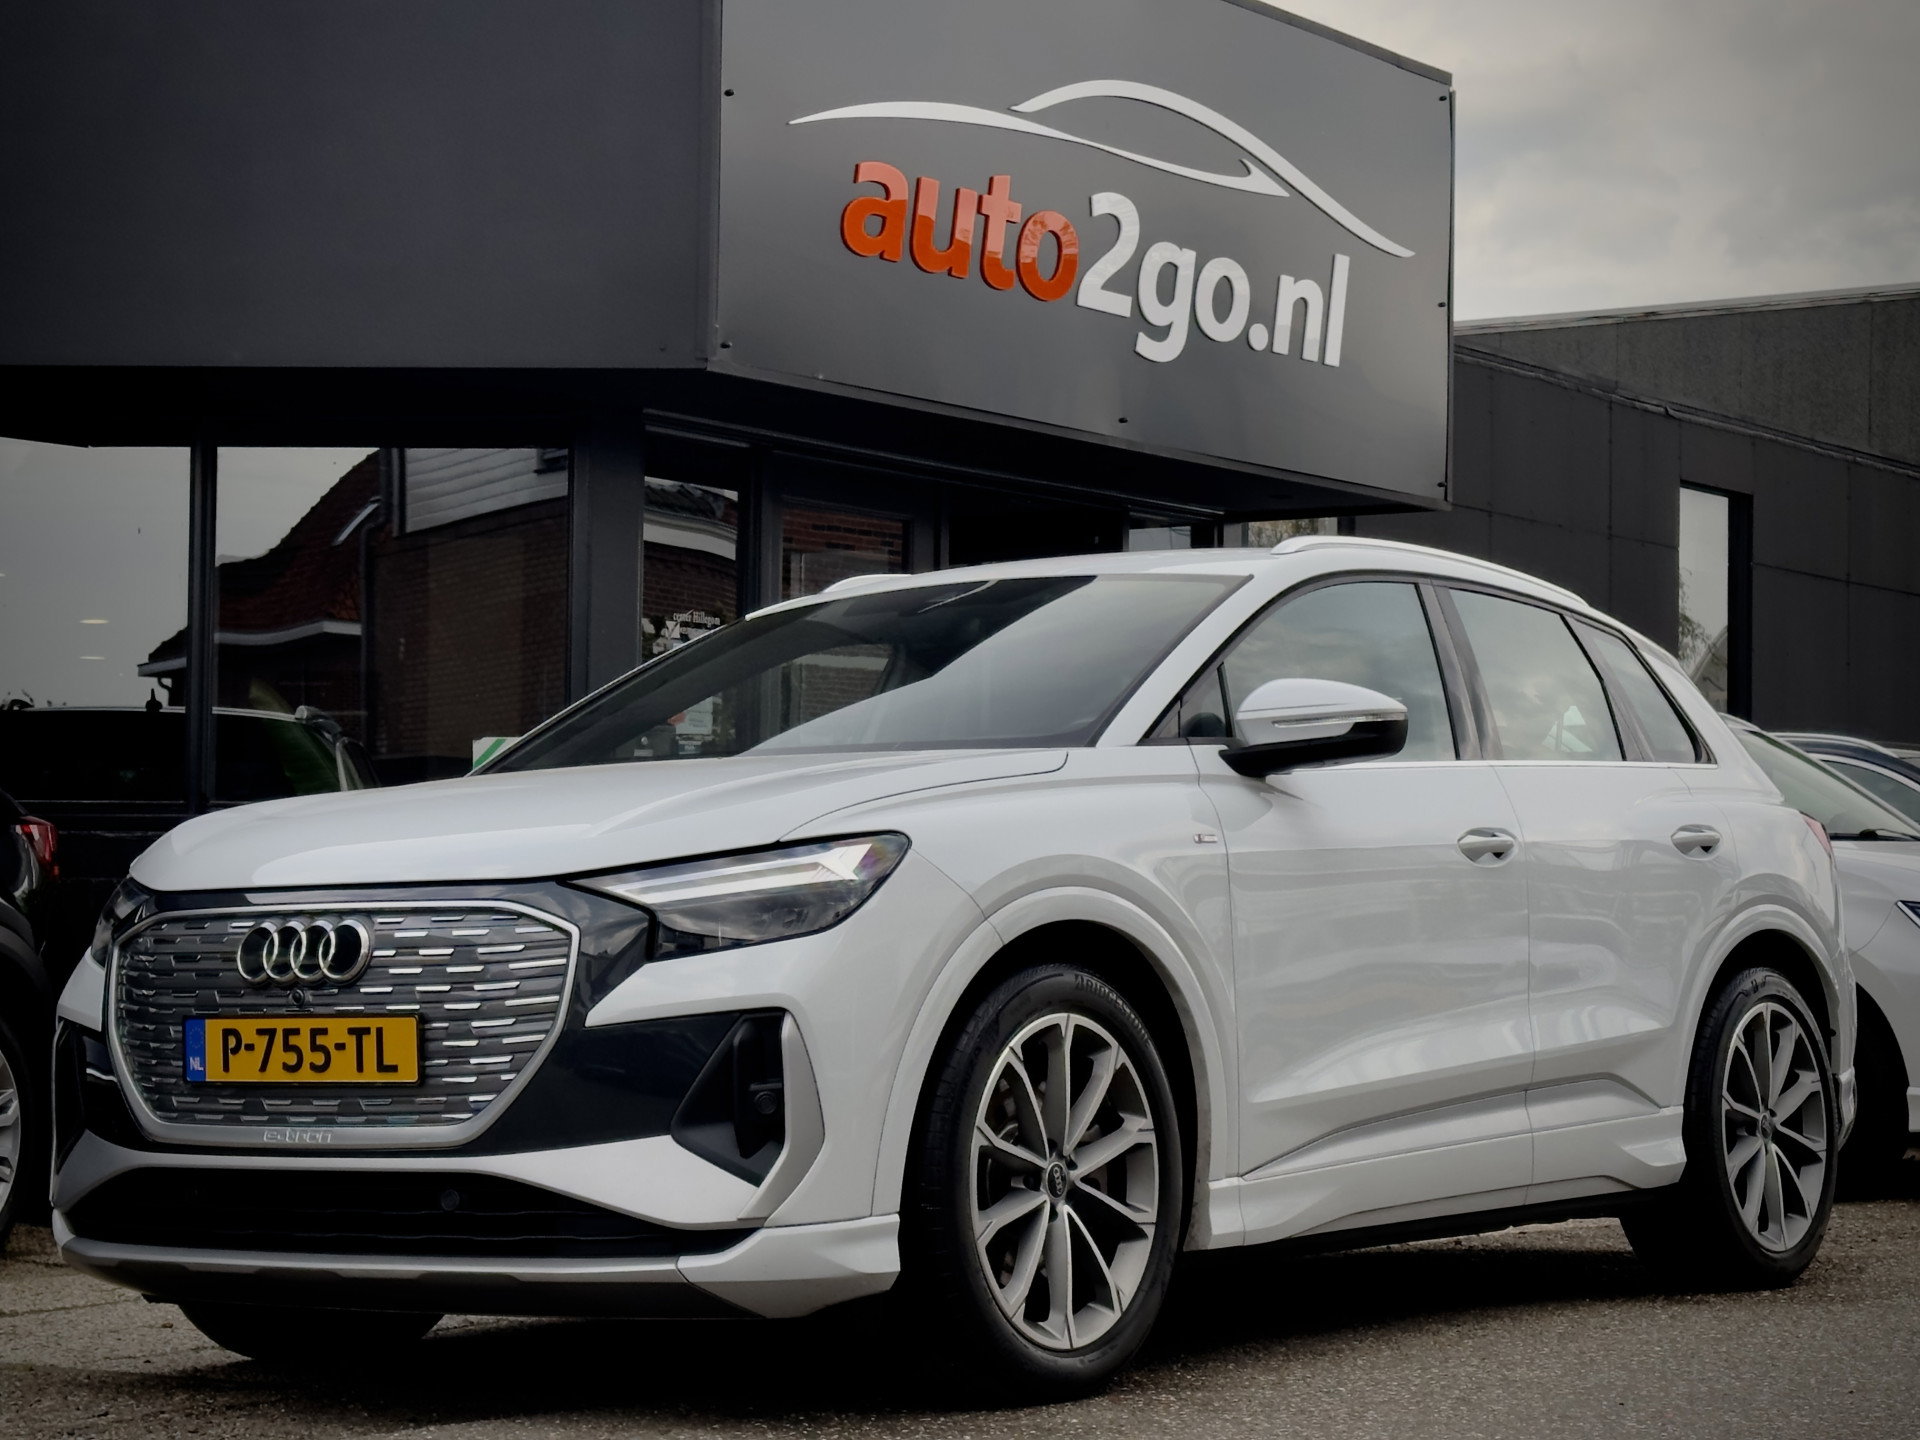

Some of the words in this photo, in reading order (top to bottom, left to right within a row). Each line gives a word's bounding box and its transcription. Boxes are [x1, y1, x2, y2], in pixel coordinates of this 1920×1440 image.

[841, 161, 1350, 367] auto2go.nl
[189, 1057, 204, 1071] NL
[222, 1027, 398, 1073] P-755-TL
